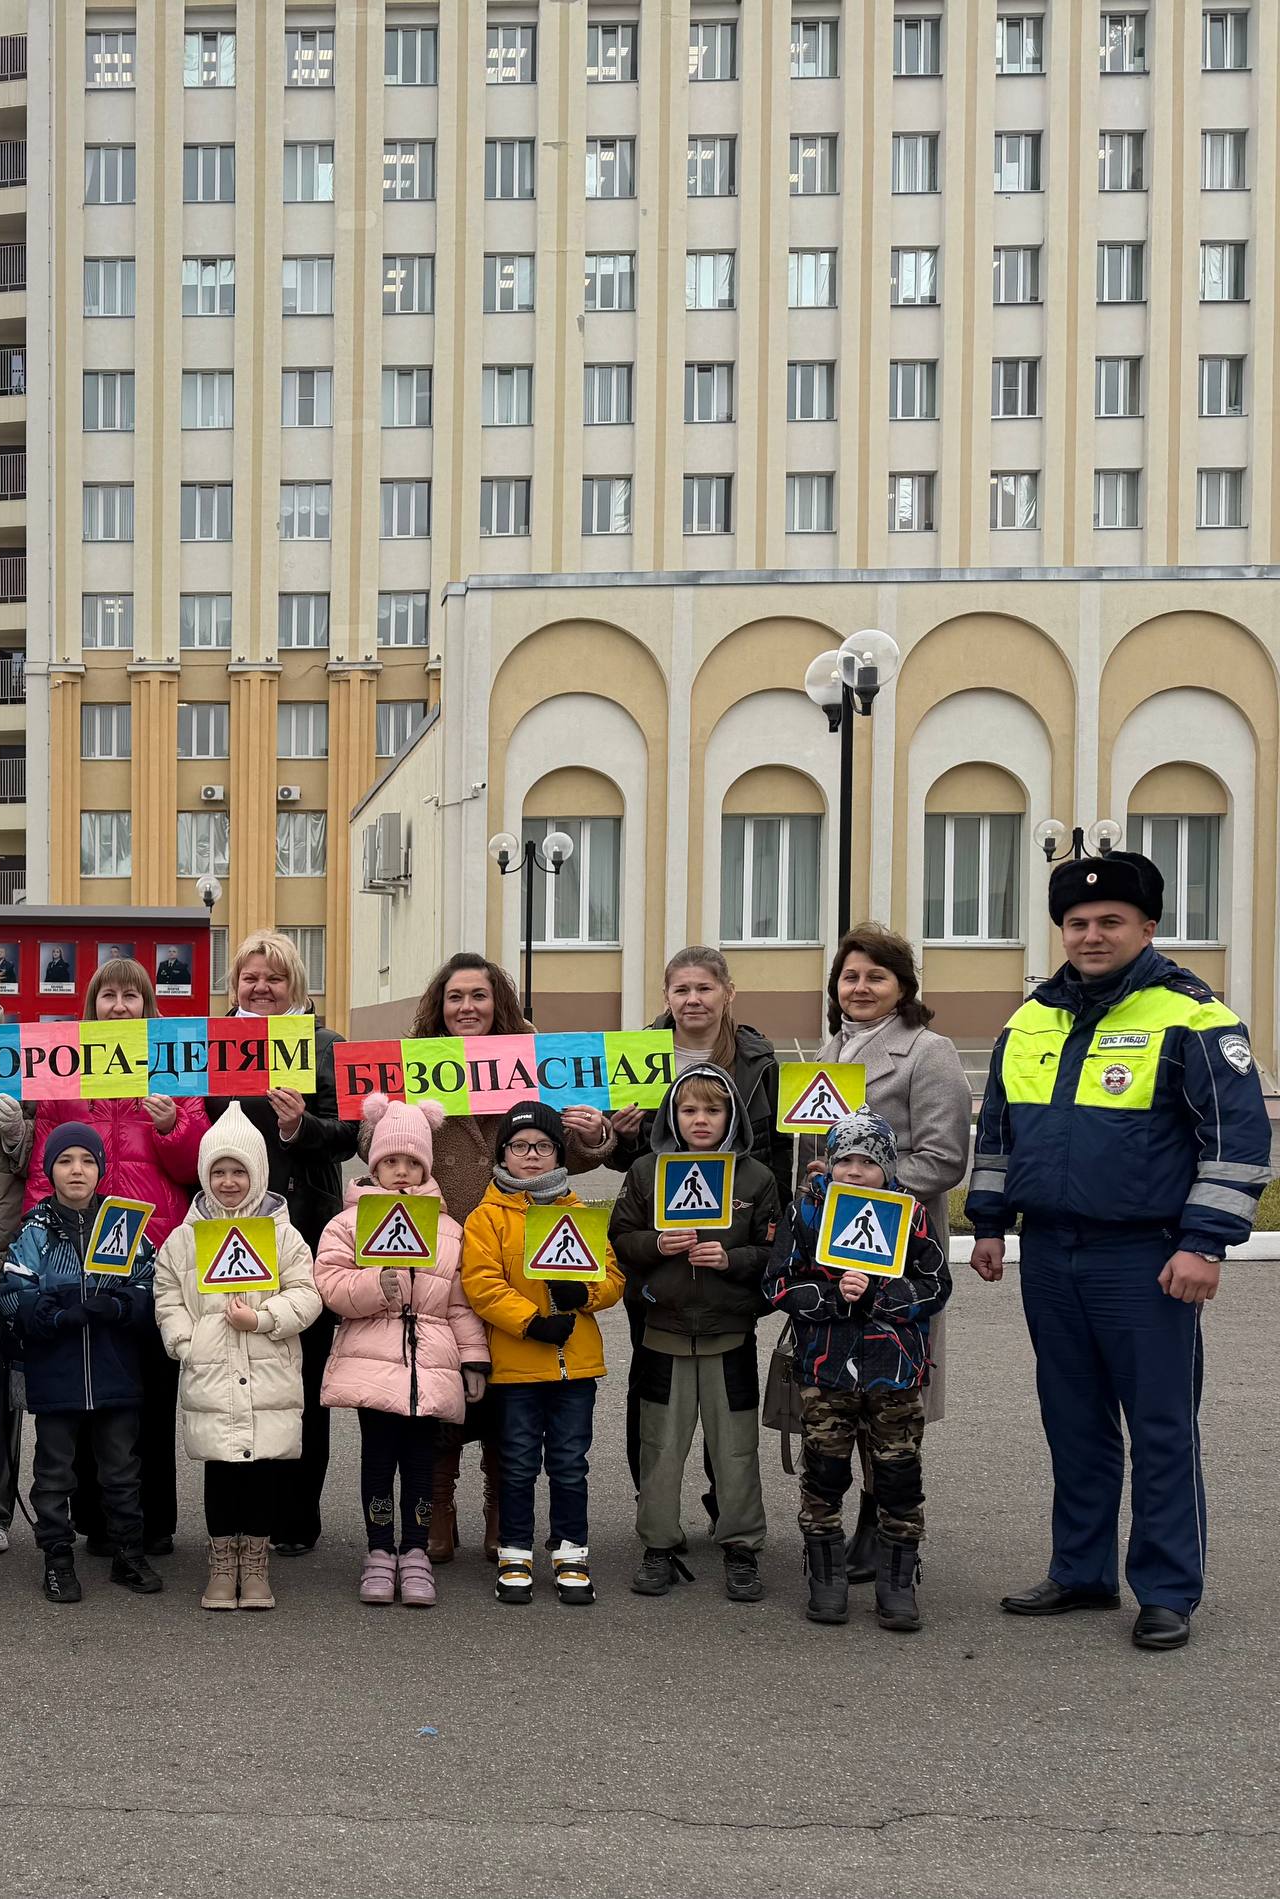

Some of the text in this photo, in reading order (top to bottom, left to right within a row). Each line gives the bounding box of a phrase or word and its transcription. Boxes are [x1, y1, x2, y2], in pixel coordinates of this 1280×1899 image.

[1100, 1035, 1148, 1046] ДПС ГИБДД
[346, 1052, 676, 1097] БЕЗОПАСНАЯ
